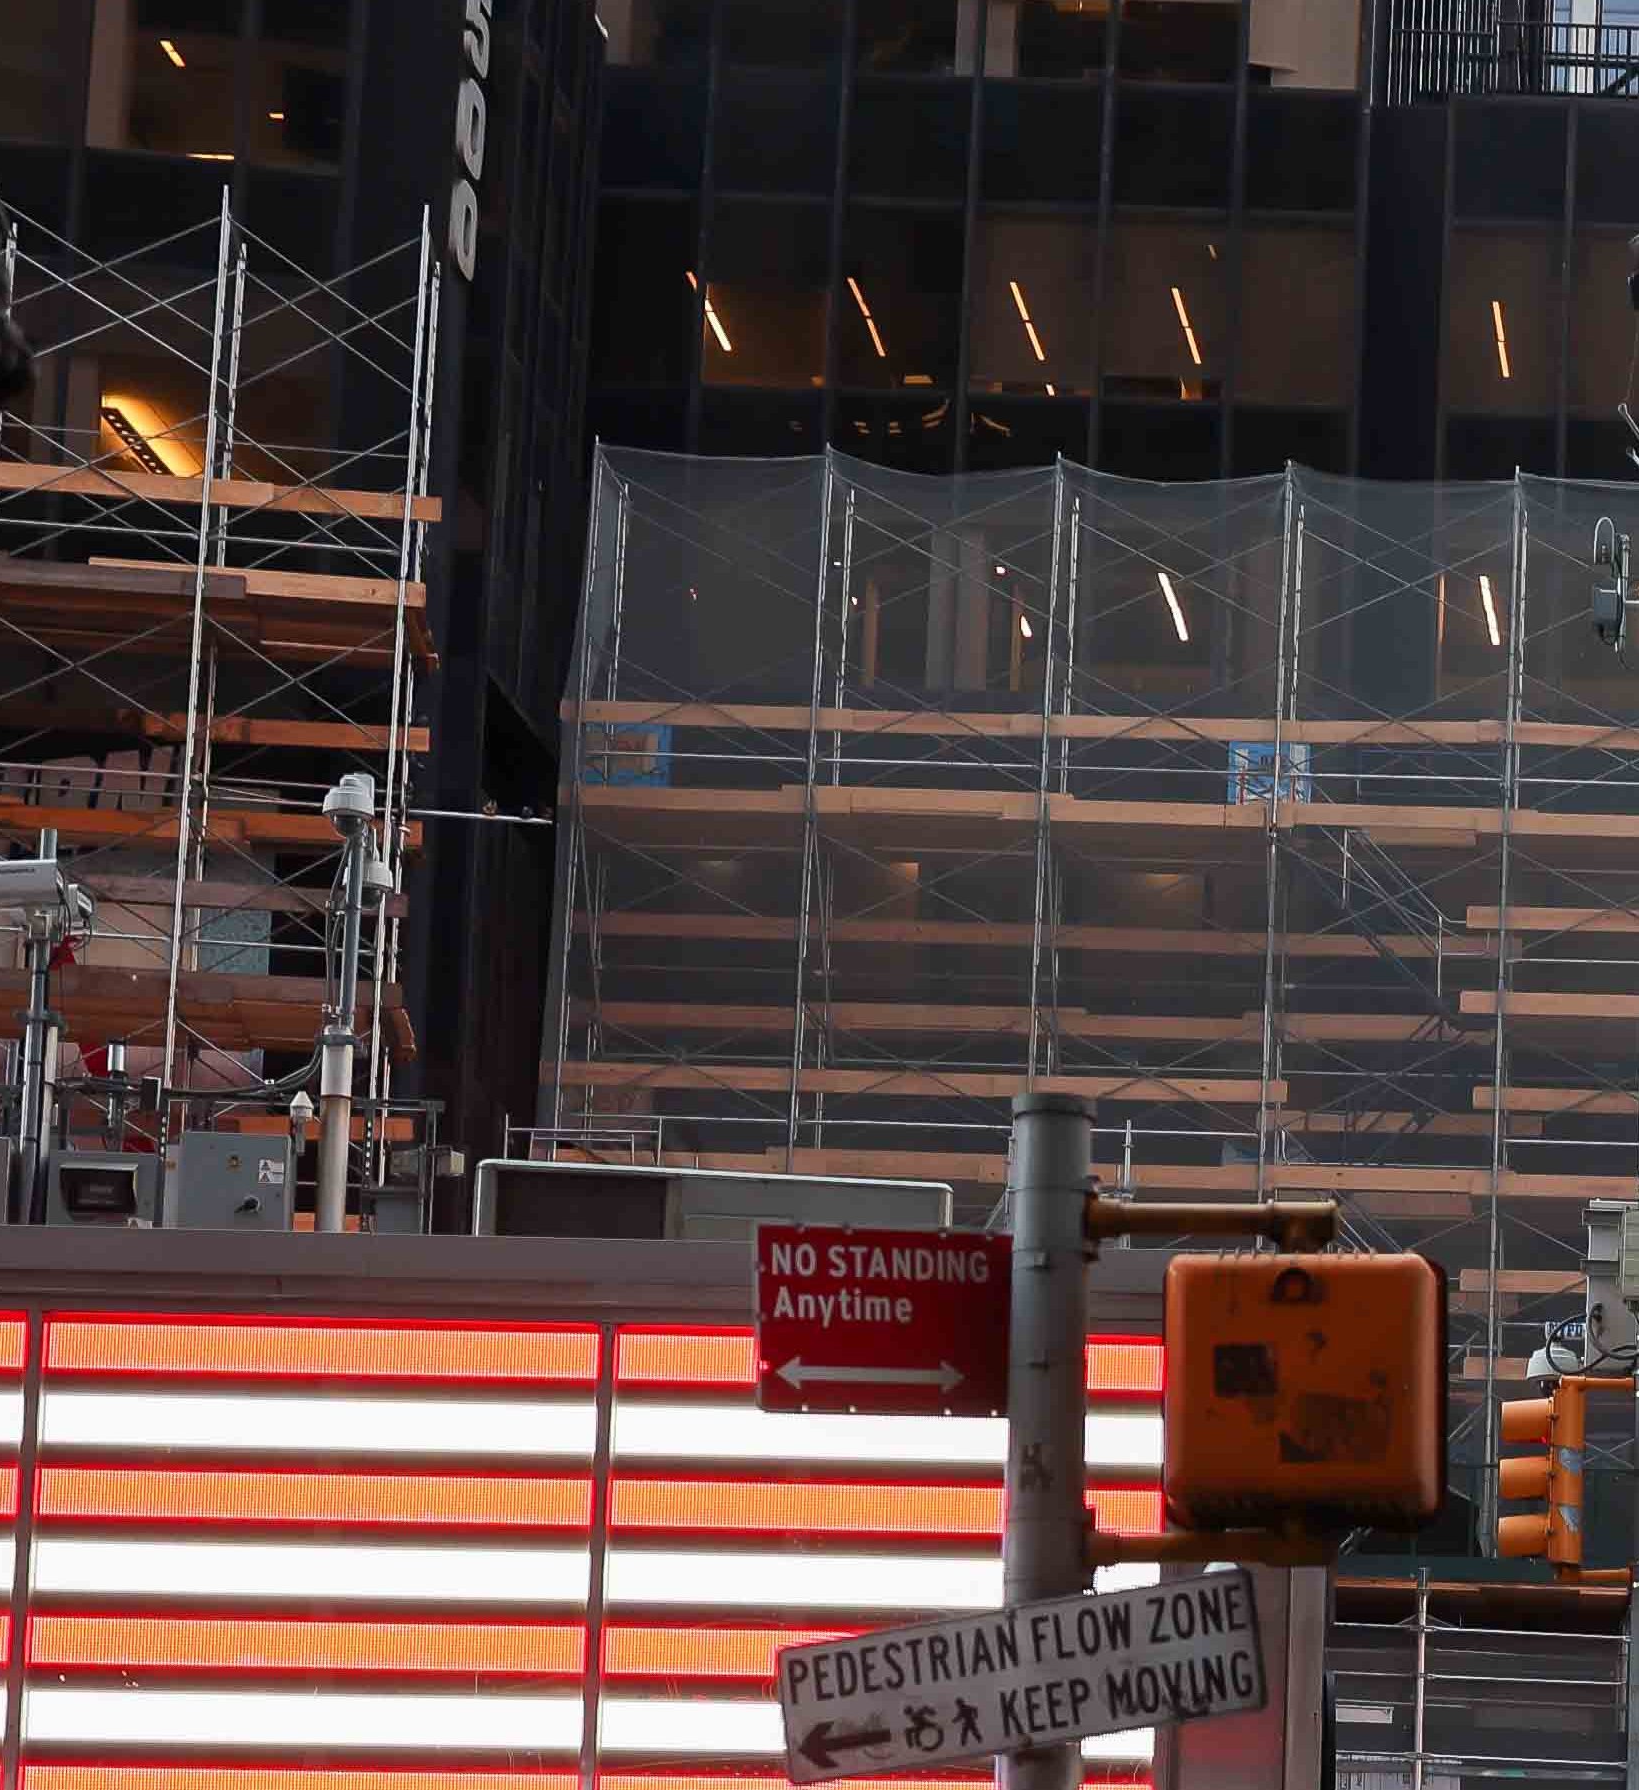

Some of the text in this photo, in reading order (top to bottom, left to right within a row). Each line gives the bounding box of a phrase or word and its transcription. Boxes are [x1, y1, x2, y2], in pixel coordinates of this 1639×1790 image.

[771, 1243, 990, 1283] NO STANDING
[773, 1285, 913, 1328] Anytime
[787, 1583, 1249, 1704] PEDESTRIAN FLOW ZONE
[999, 1651, 1253, 1738] KEEP MOVING
